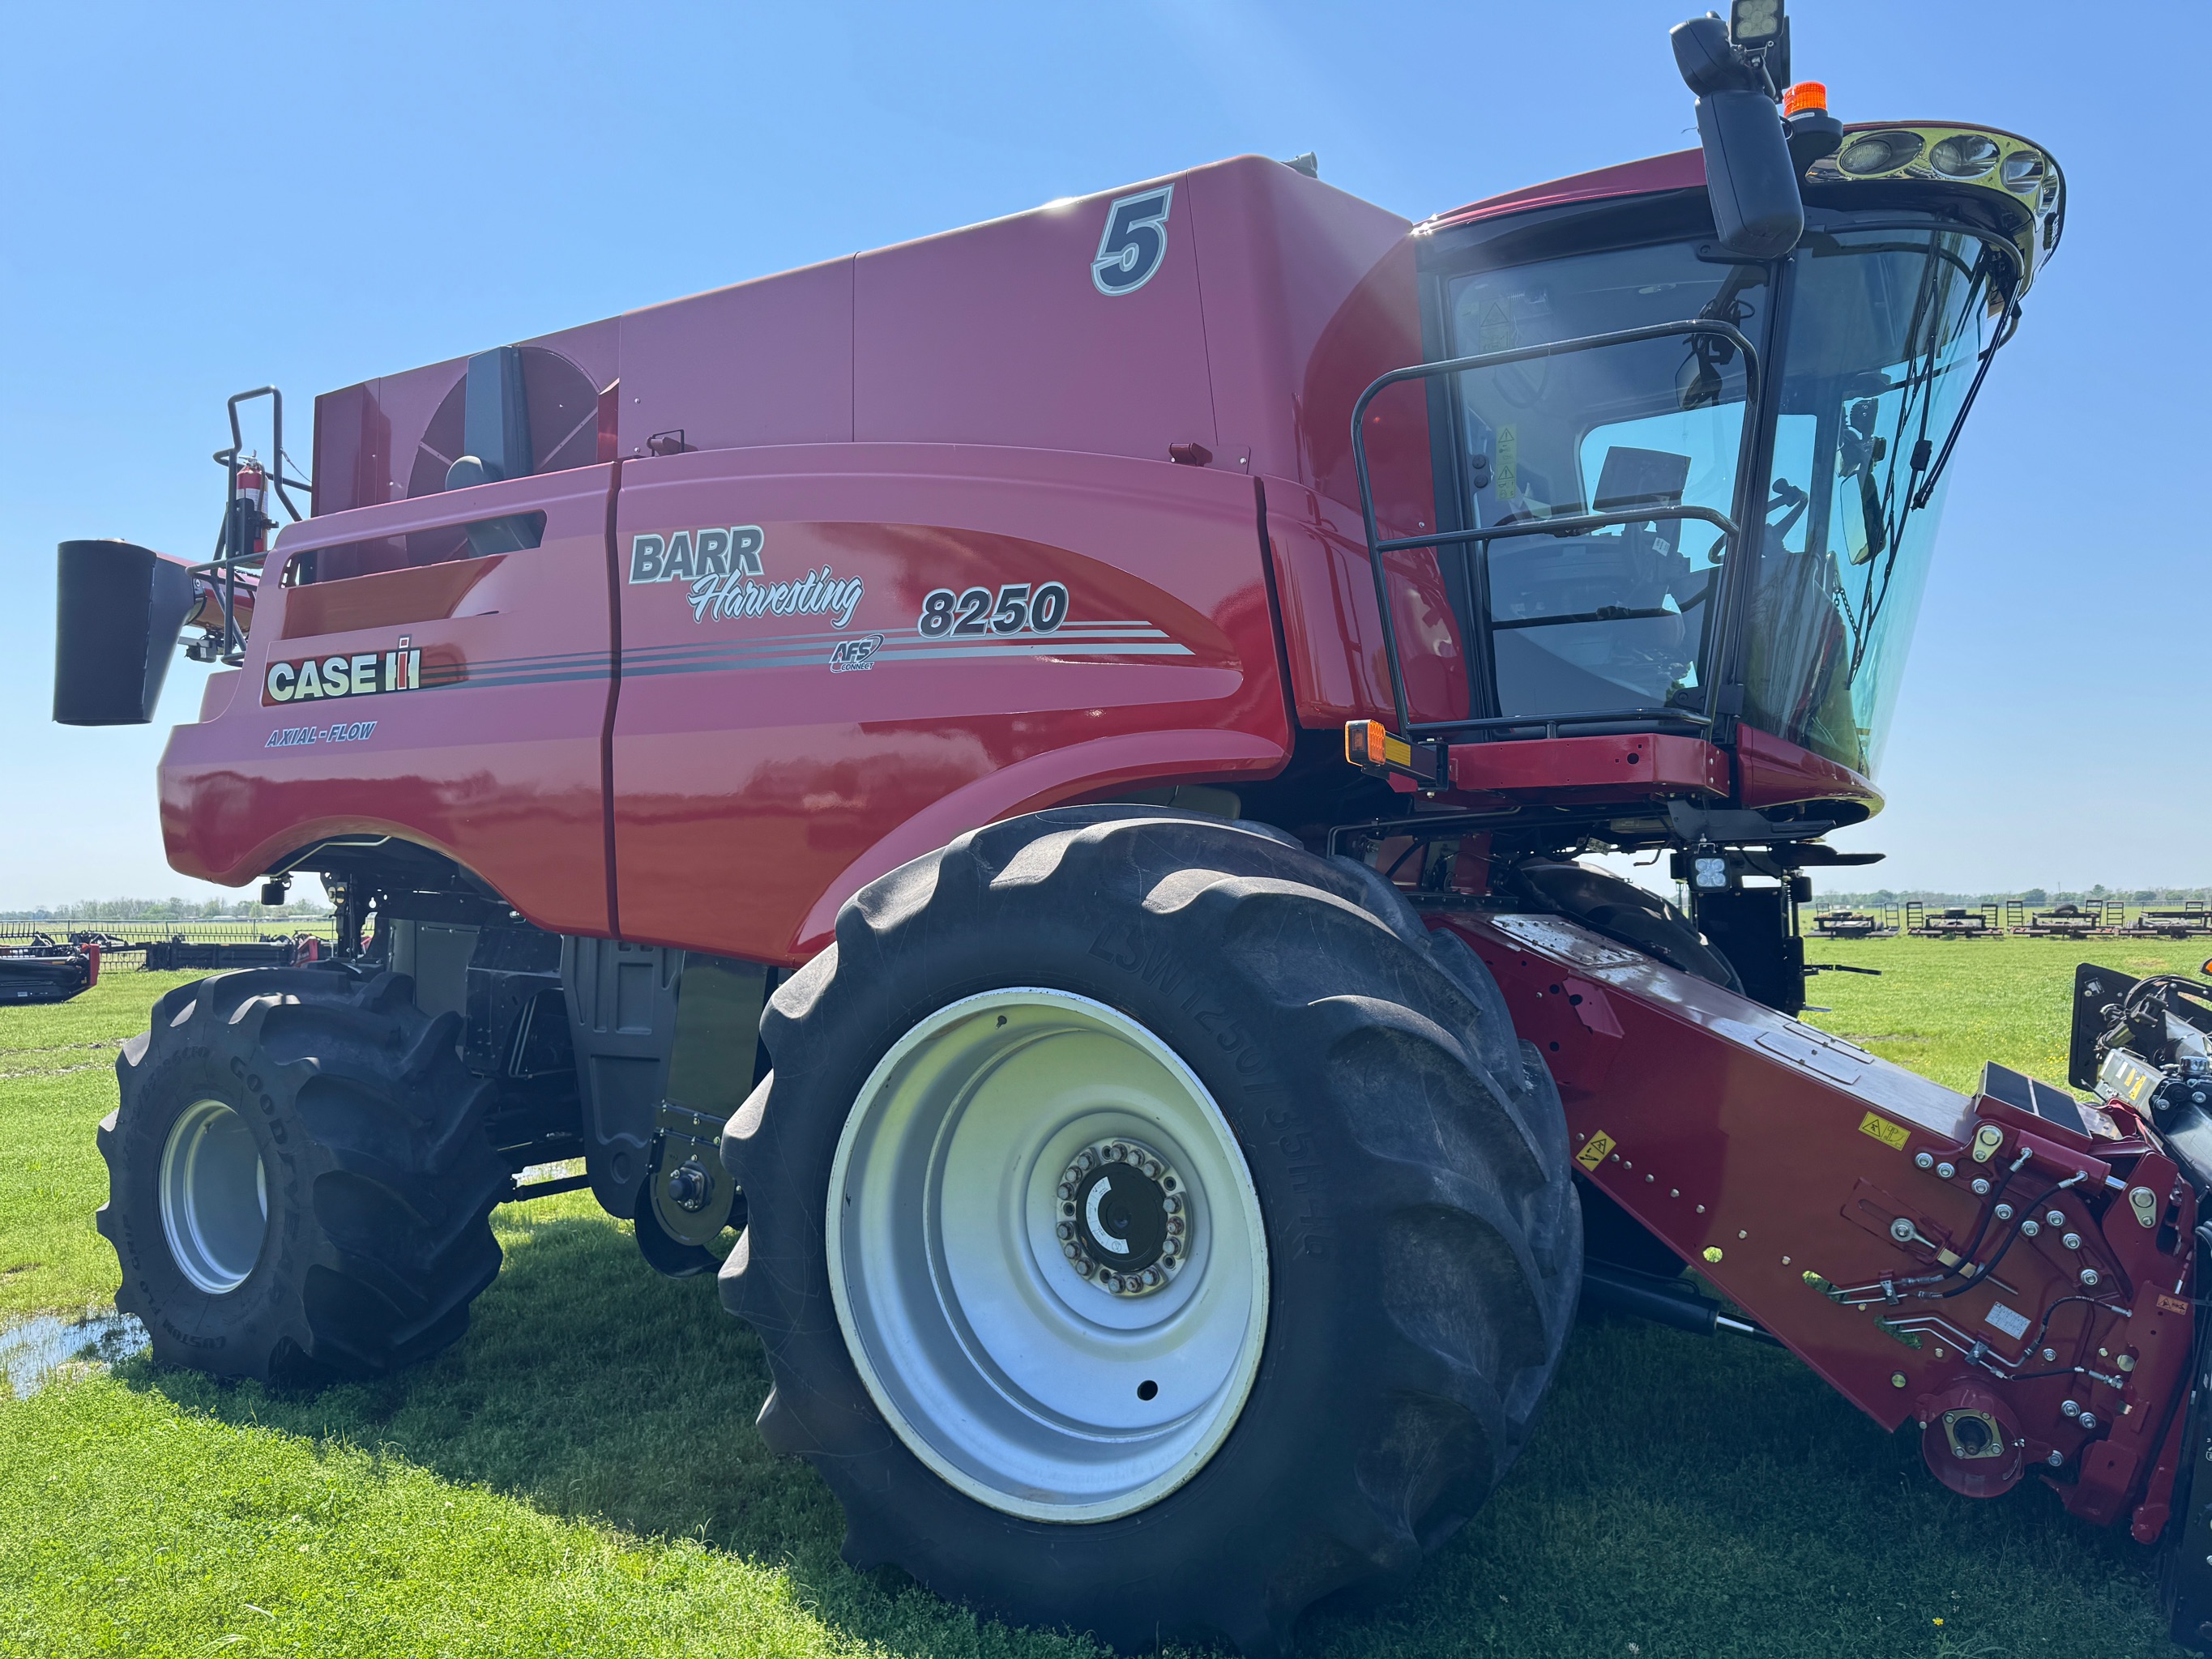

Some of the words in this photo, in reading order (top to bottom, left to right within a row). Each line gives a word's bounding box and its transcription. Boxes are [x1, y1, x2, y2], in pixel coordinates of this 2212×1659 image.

[1090, 183, 1175, 296] 5
[629, 525, 765, 584] BARR
[687, 564, 865, 629] Harvesting
[917, 581, 1070, 639] 8250
[267, 653, 378, 702] CASE
[829, 639, 874, 664] AFS
[840, 661, 875, 672] CONNECT
[163, 1318, 227, 1350] CUSTOM
